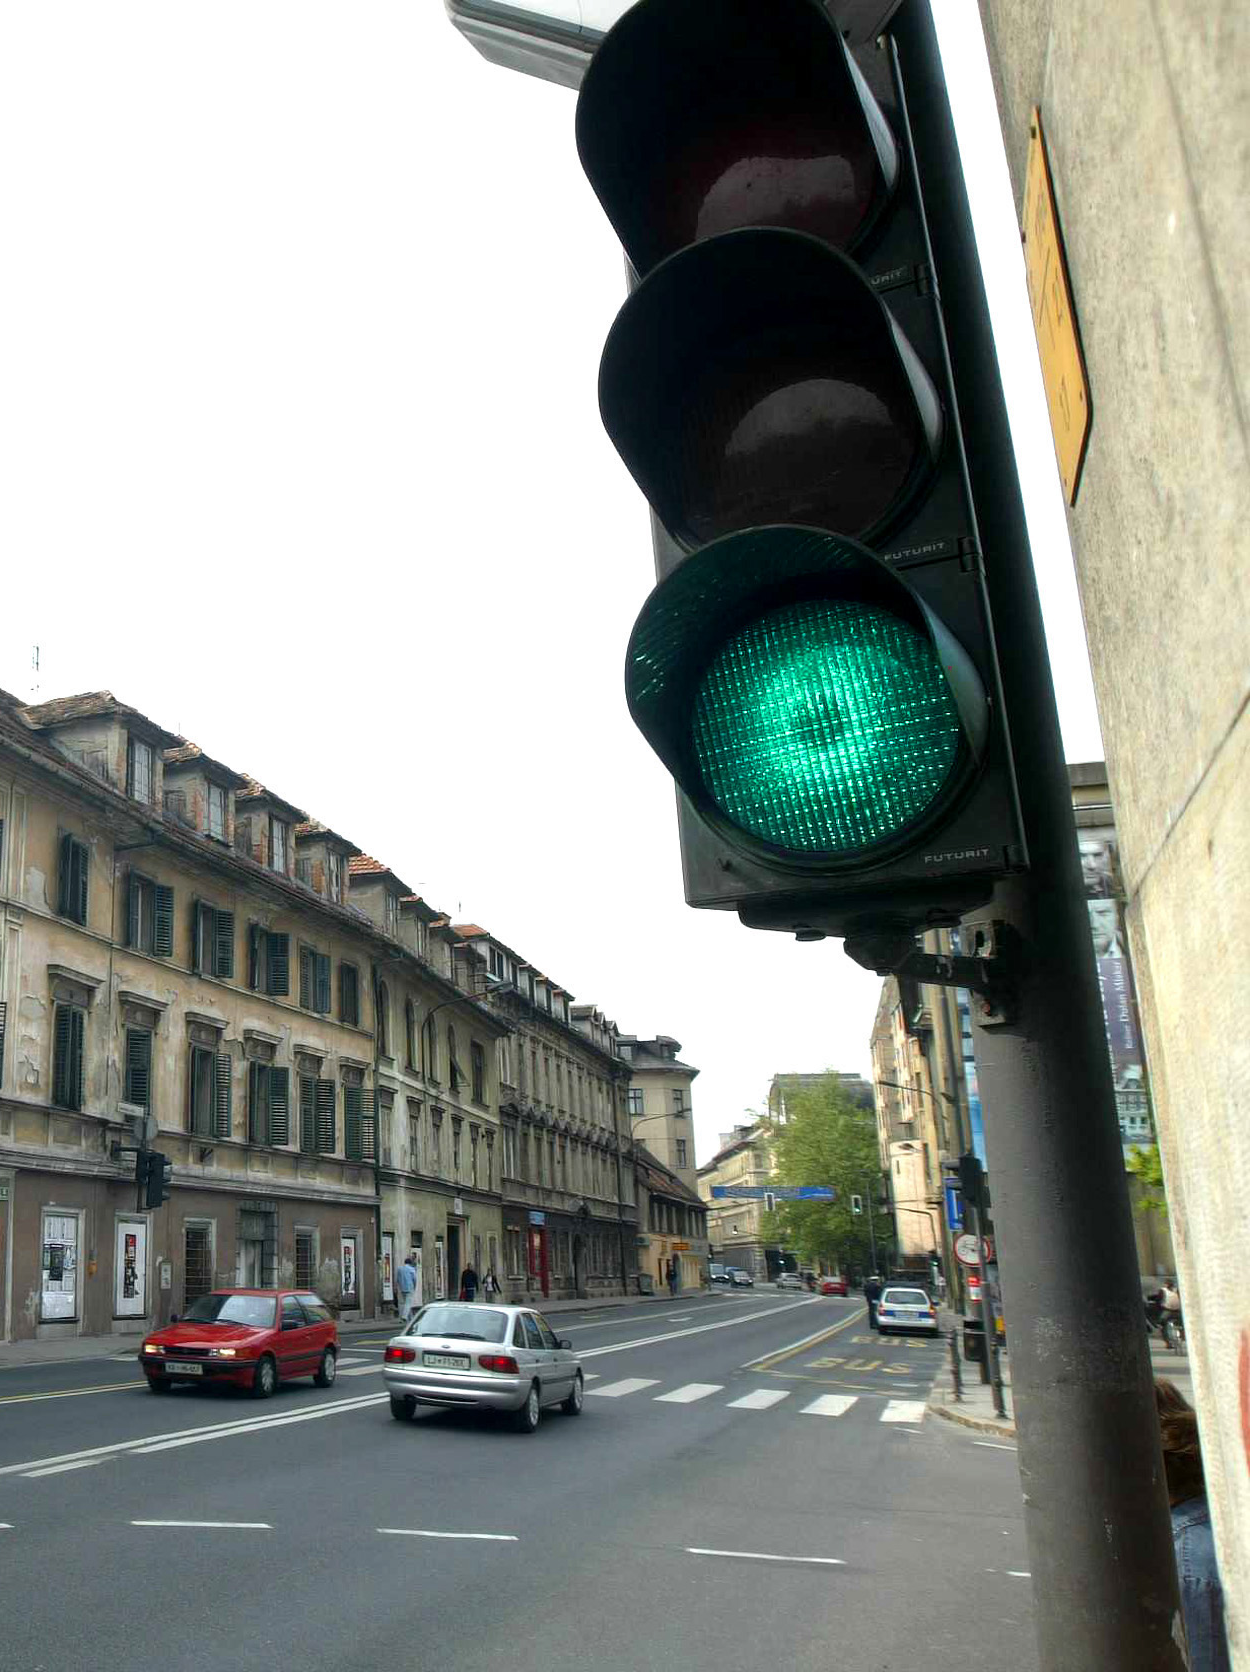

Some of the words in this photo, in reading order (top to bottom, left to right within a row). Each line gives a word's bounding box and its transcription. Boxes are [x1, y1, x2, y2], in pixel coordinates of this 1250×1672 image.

[884, 542, 946, 562] FUTURIT
[924, 848, 990, 864] FUTURIT
[851, 1335, 928, 1348] BUS
[802, 1356, 913, 1374] BUS
